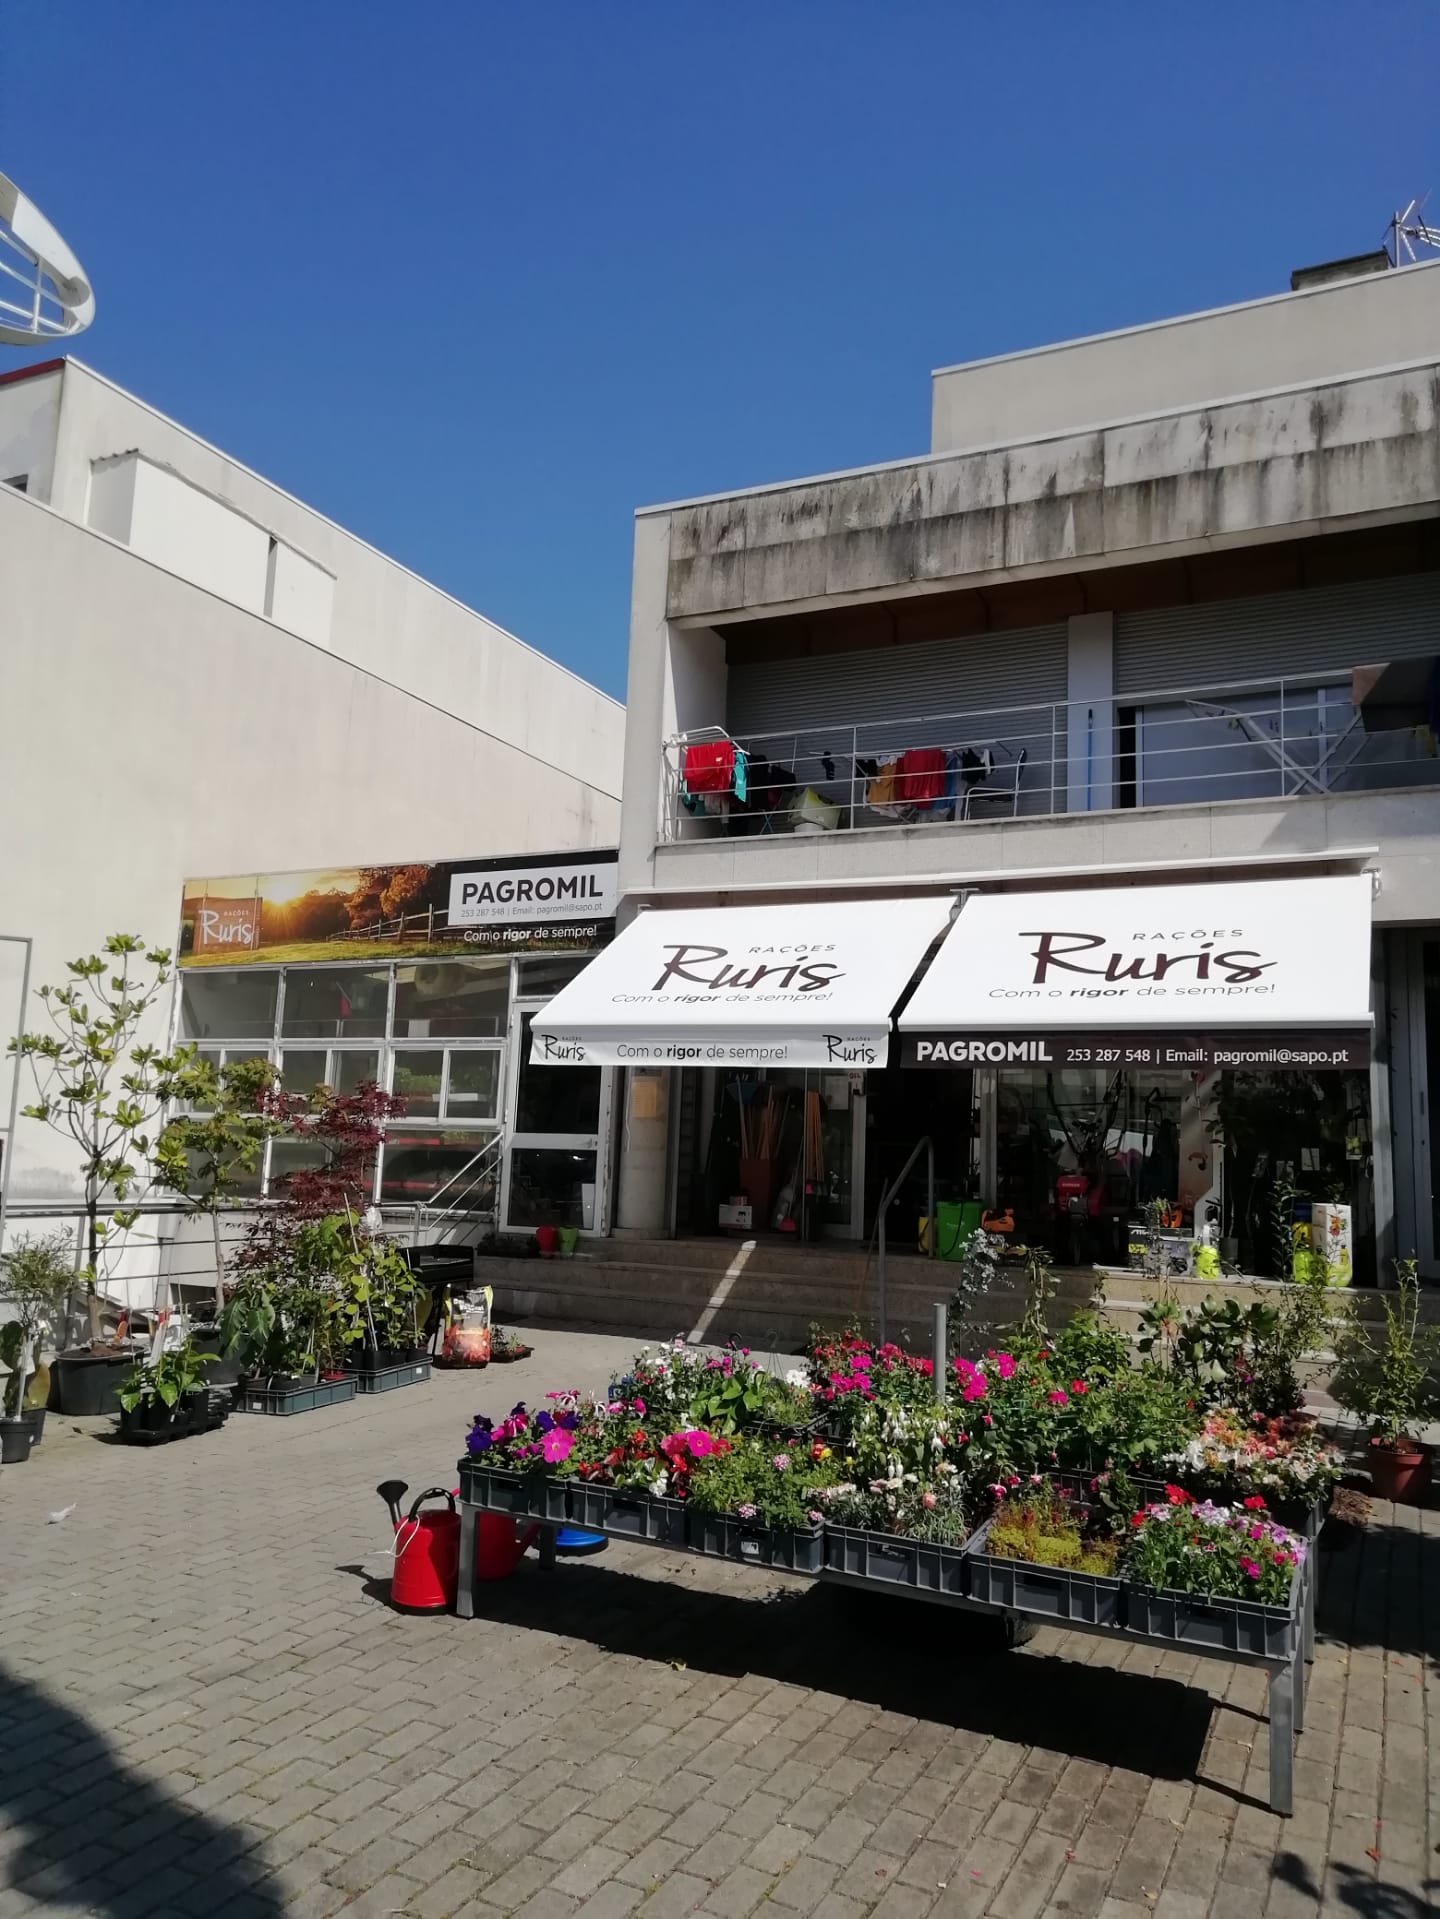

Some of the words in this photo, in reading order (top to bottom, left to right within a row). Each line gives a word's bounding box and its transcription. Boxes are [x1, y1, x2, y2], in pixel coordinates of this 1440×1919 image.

[462, 875, 603, 905] PAGROMIL
[461, 909, 474, 918] 253
[476, 908, 489, 917] 287
[491, 907, 505, 916] 548
[536, 902, 603, 916] pagromil@sapo.pt
[198, 909, 253, 945] Ruris
[464, 930, 490, 942] Com
[492, 931, 501, 941] o
[503, 928, 531, 942] rigor
[534, 926, 549, 939] de
[551, 925, 597, 939] sempre!
[1132, 929, 1243, 941] RAÇÕES
[748, 944, 837, 954] RAÇÕES
[1018, 932, 1278, 984] Ruris
[651, 945, 847, 991] Ruris
[612, 993, 651, 1003] Com
[657, 994, 670, 1003] o
[673, 992, 722, 1004] rigor
[725, 993, 750, 1002] de
[753, 992, 833, 1003] sempre!
[989, 988, 1040, 998] Com
[1047, 989, 1062, 998] o
[1069, 986, 1129, 999] rigor
[1136, 985, 1168, 997] de
[1174, 984, 1276, 998] sempre!
[541, 1034, 586, 1061] Ruris
[617, 1044, 649, 1058] Com
[653, 1047, 663, 1058] o
[667, 1044, 702, 1060] rigor
[706, 1045, 725, 1059] de
[729, 1045, 788, 1061] sempre!
[822, 1034, 878, 1064] Ruris
[916, 1041, 1054, 1062] PAGROMIL
[1066, 1049, 1091, 1062] 253
[1095, 1049, 1121, 1062] 287
[1124, 1049, 1151, 1062] 548
[1165, 1048, 1208, 1062] Email:
[1213, 1048, 1349, 1065] pagromil@sapo.pt
